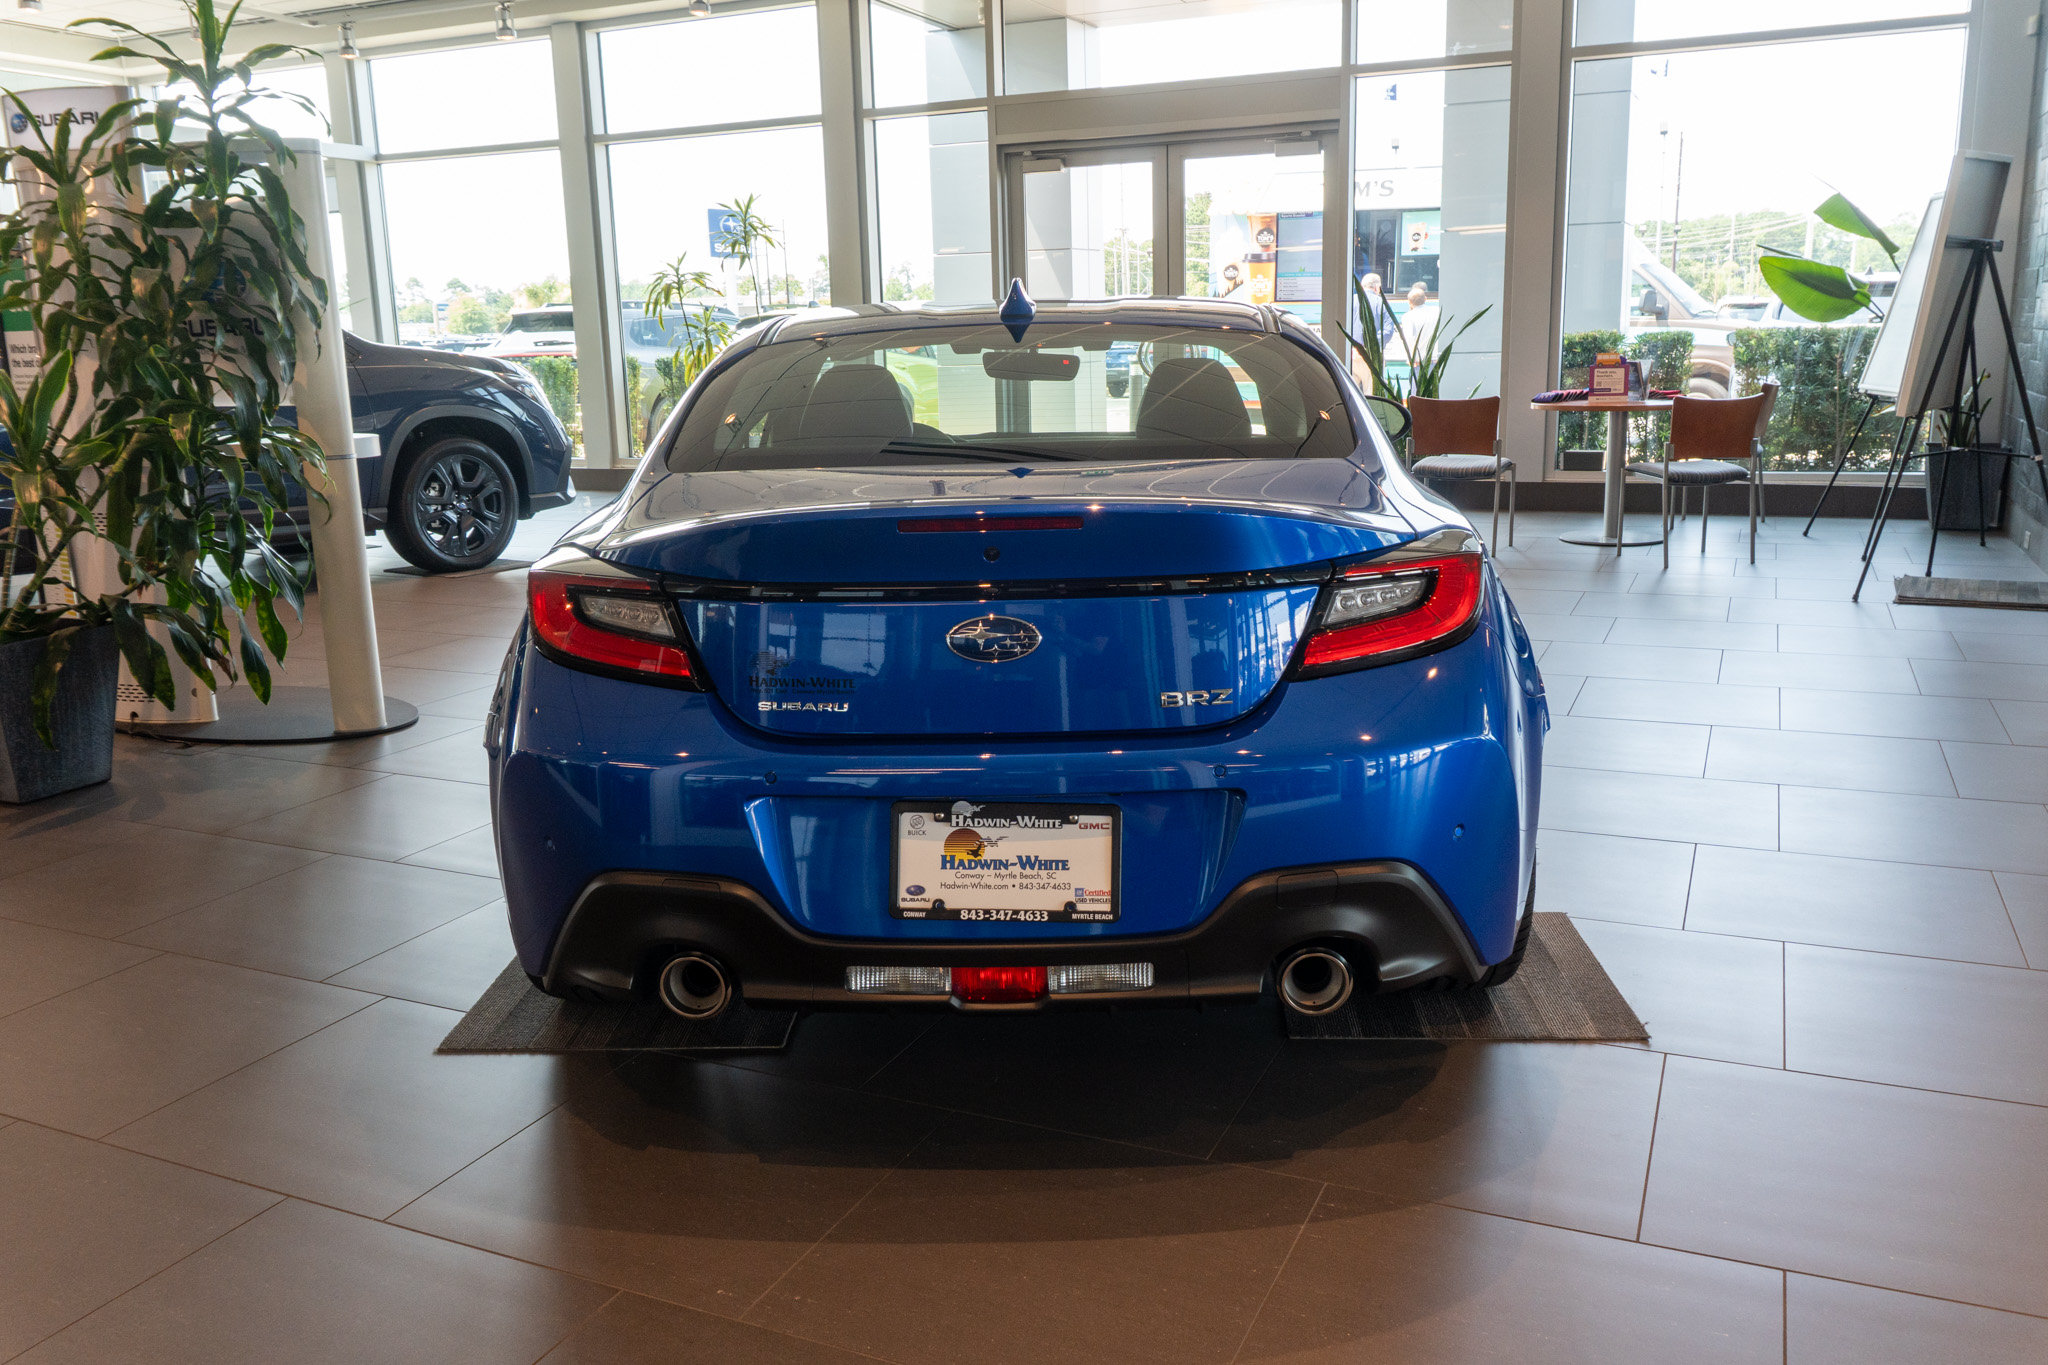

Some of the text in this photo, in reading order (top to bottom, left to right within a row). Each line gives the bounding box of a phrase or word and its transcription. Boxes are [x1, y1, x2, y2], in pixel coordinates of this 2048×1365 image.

[748, 676, 857, 688] HADWIN-WHITE
[1161, 688, 1233, 708] BRZ
[757, 701, 849, 712] SUBARU
[951, 814, 1062, 829] HADWIN-WHITE
[940, 854, 1070, 870] HADWIN-WHITE
[955, 872, 984, 880] Conway
[994, 872, 1017, 881] Myrtle
[1020, 872, 1044, 880] Beach,
[940, 882, 1072, 890] Hadwin-White.com 843-347-4633
[960, 910, 1048, 921] 843-347-4633
